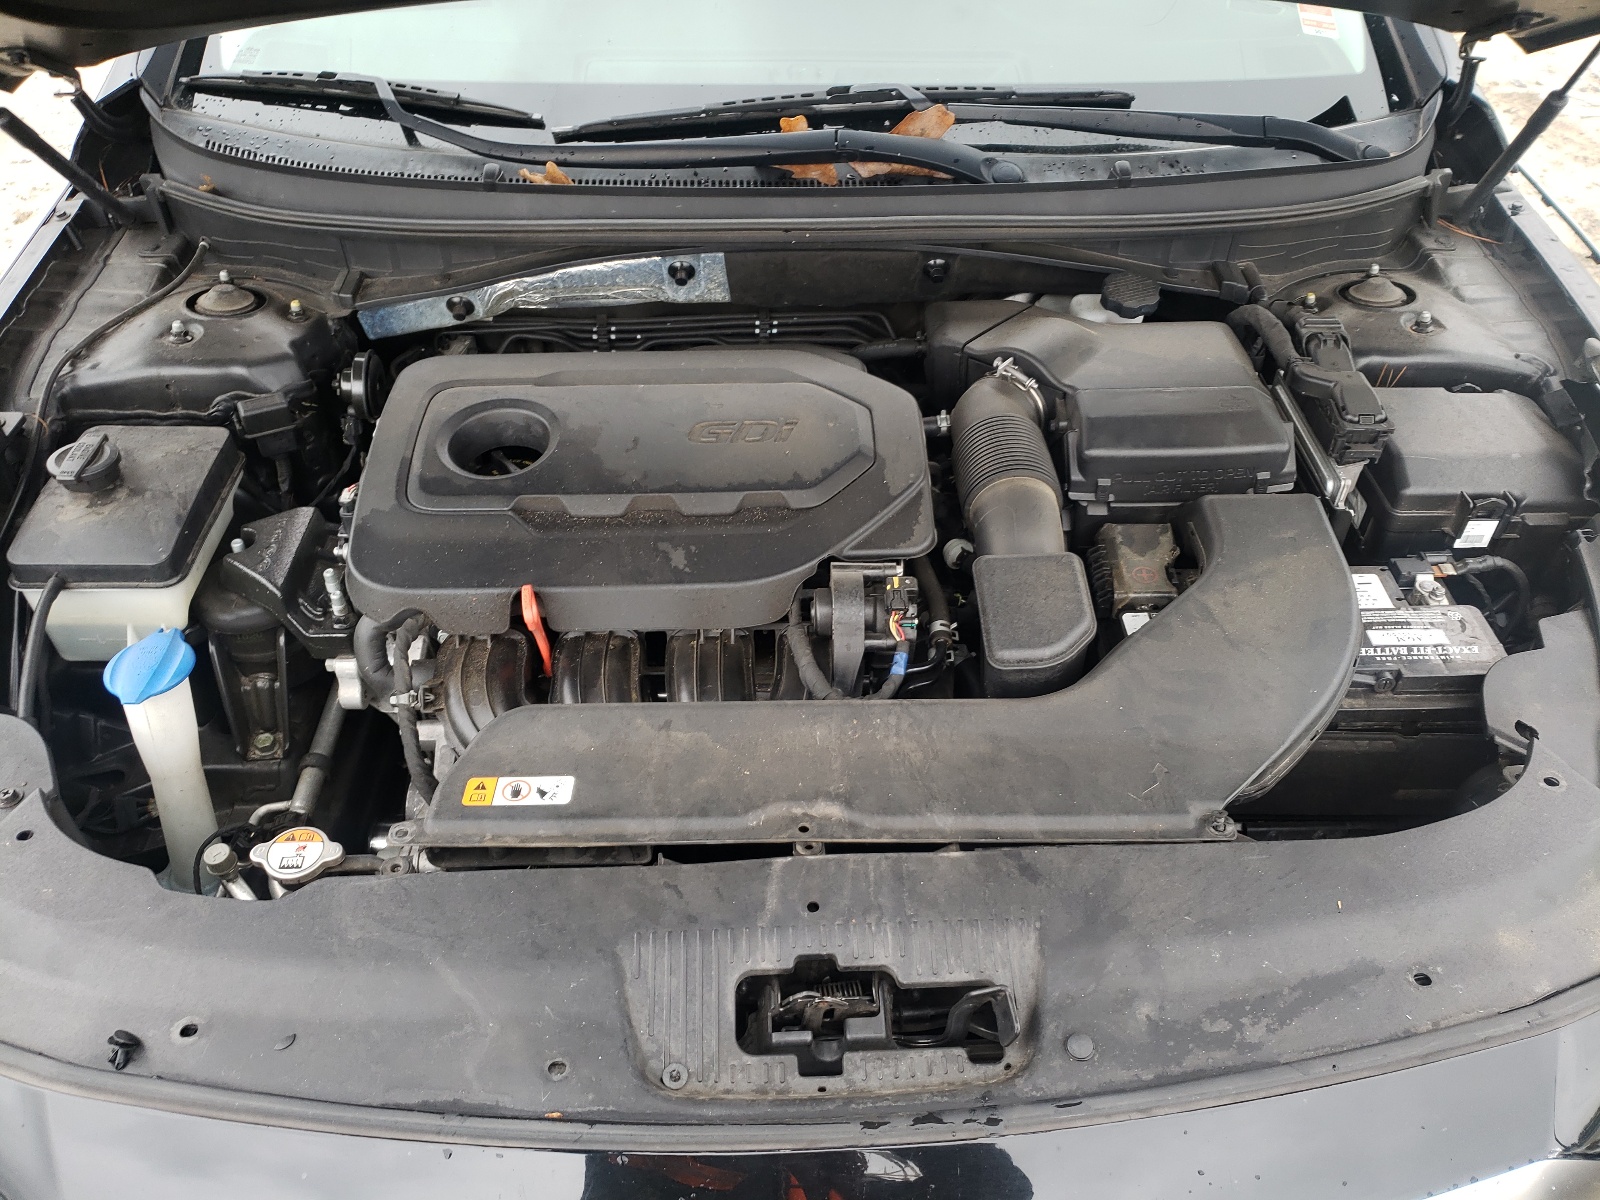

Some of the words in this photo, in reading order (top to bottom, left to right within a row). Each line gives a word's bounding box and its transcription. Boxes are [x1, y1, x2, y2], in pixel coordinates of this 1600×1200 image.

[1112, 472, 1150, 483] PULL
[1155, 471, 1187, 482] OUT
[1191, 470, 1209, 481] TO
[1214, 467, 1256, 480] OPEN
[1411, 645, 1479, 654] EXACT-FIT
